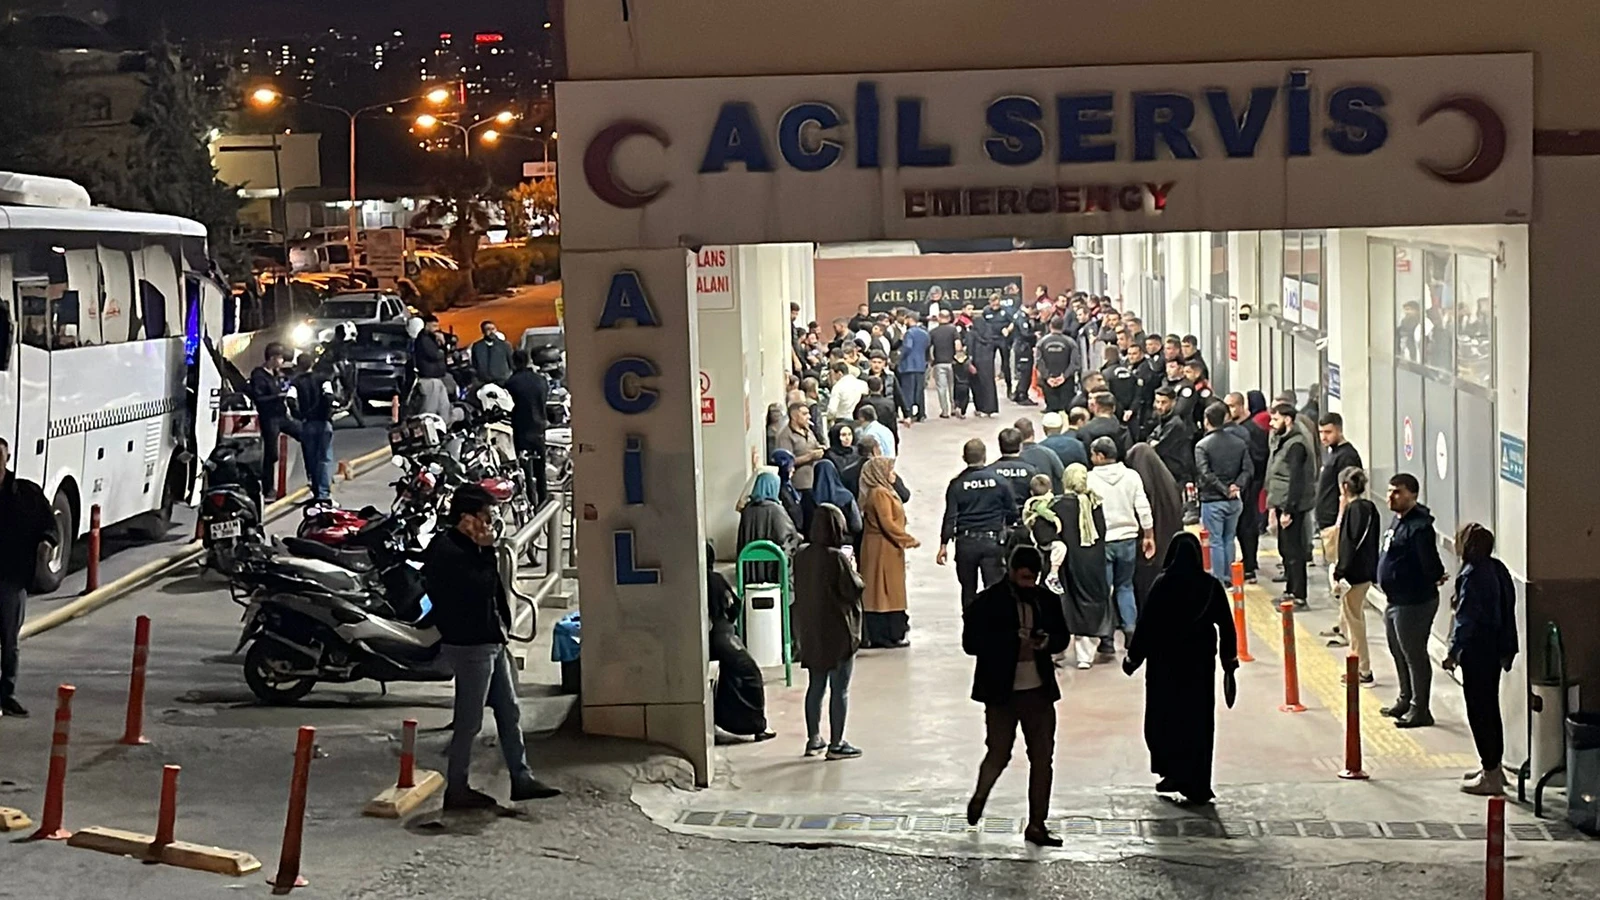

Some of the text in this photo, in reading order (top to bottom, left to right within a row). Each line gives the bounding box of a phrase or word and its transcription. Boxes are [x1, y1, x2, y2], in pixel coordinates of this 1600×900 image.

[699, 69, 1388, 172] ACİL SERVİS
[905, 180, 1177, 217] EMERGENCY
[696, 276, 729, 293] ALANI
[874, 290, 904, 302] ACİL
[597, 269, 661, 585] ACİL
